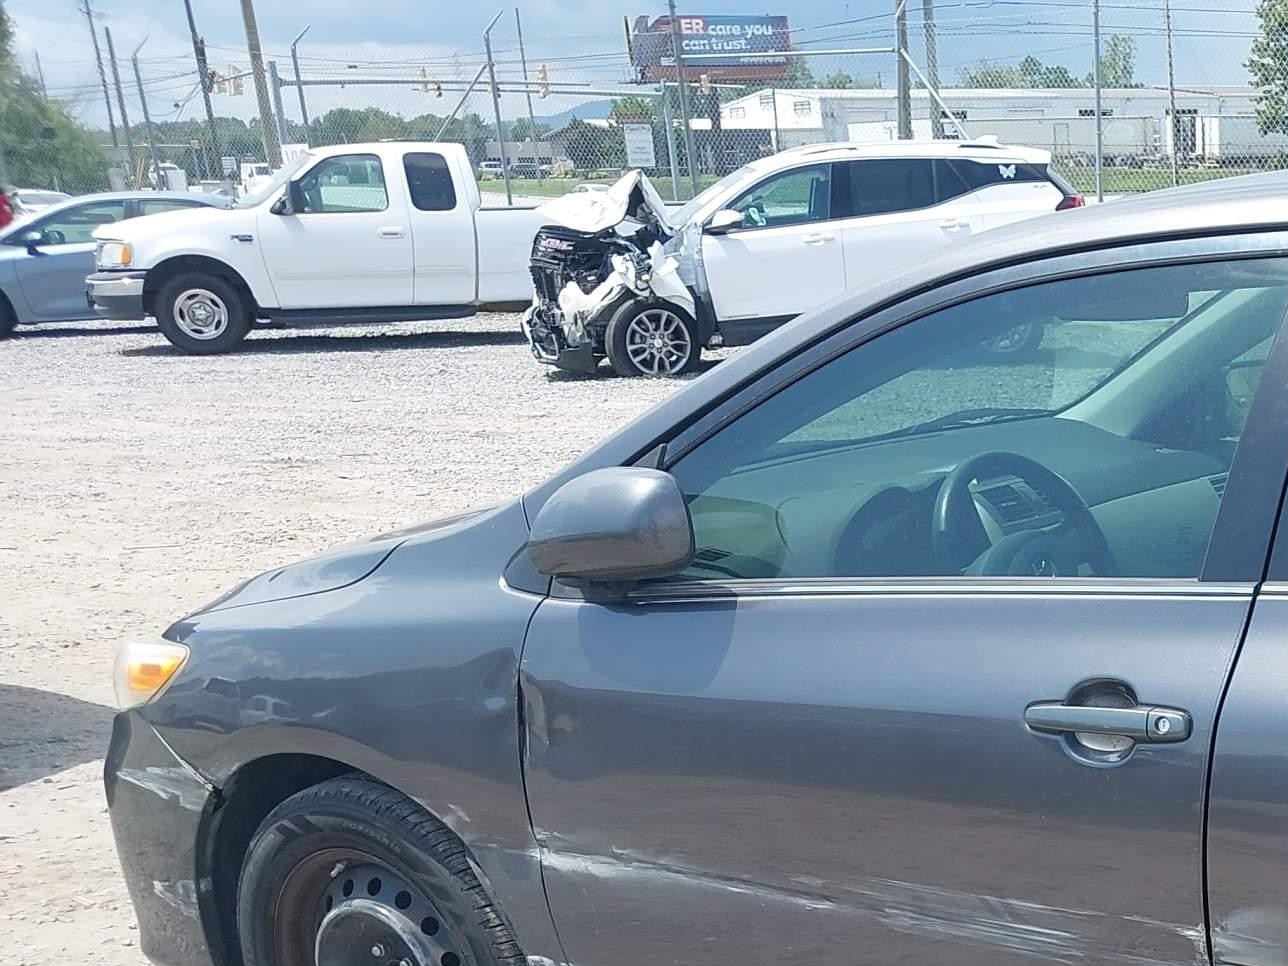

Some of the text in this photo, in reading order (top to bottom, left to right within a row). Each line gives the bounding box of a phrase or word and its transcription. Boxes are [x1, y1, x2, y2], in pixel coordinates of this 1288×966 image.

[680, 18, 773, 38] ER care you
[682, 39, 709, 51] can
